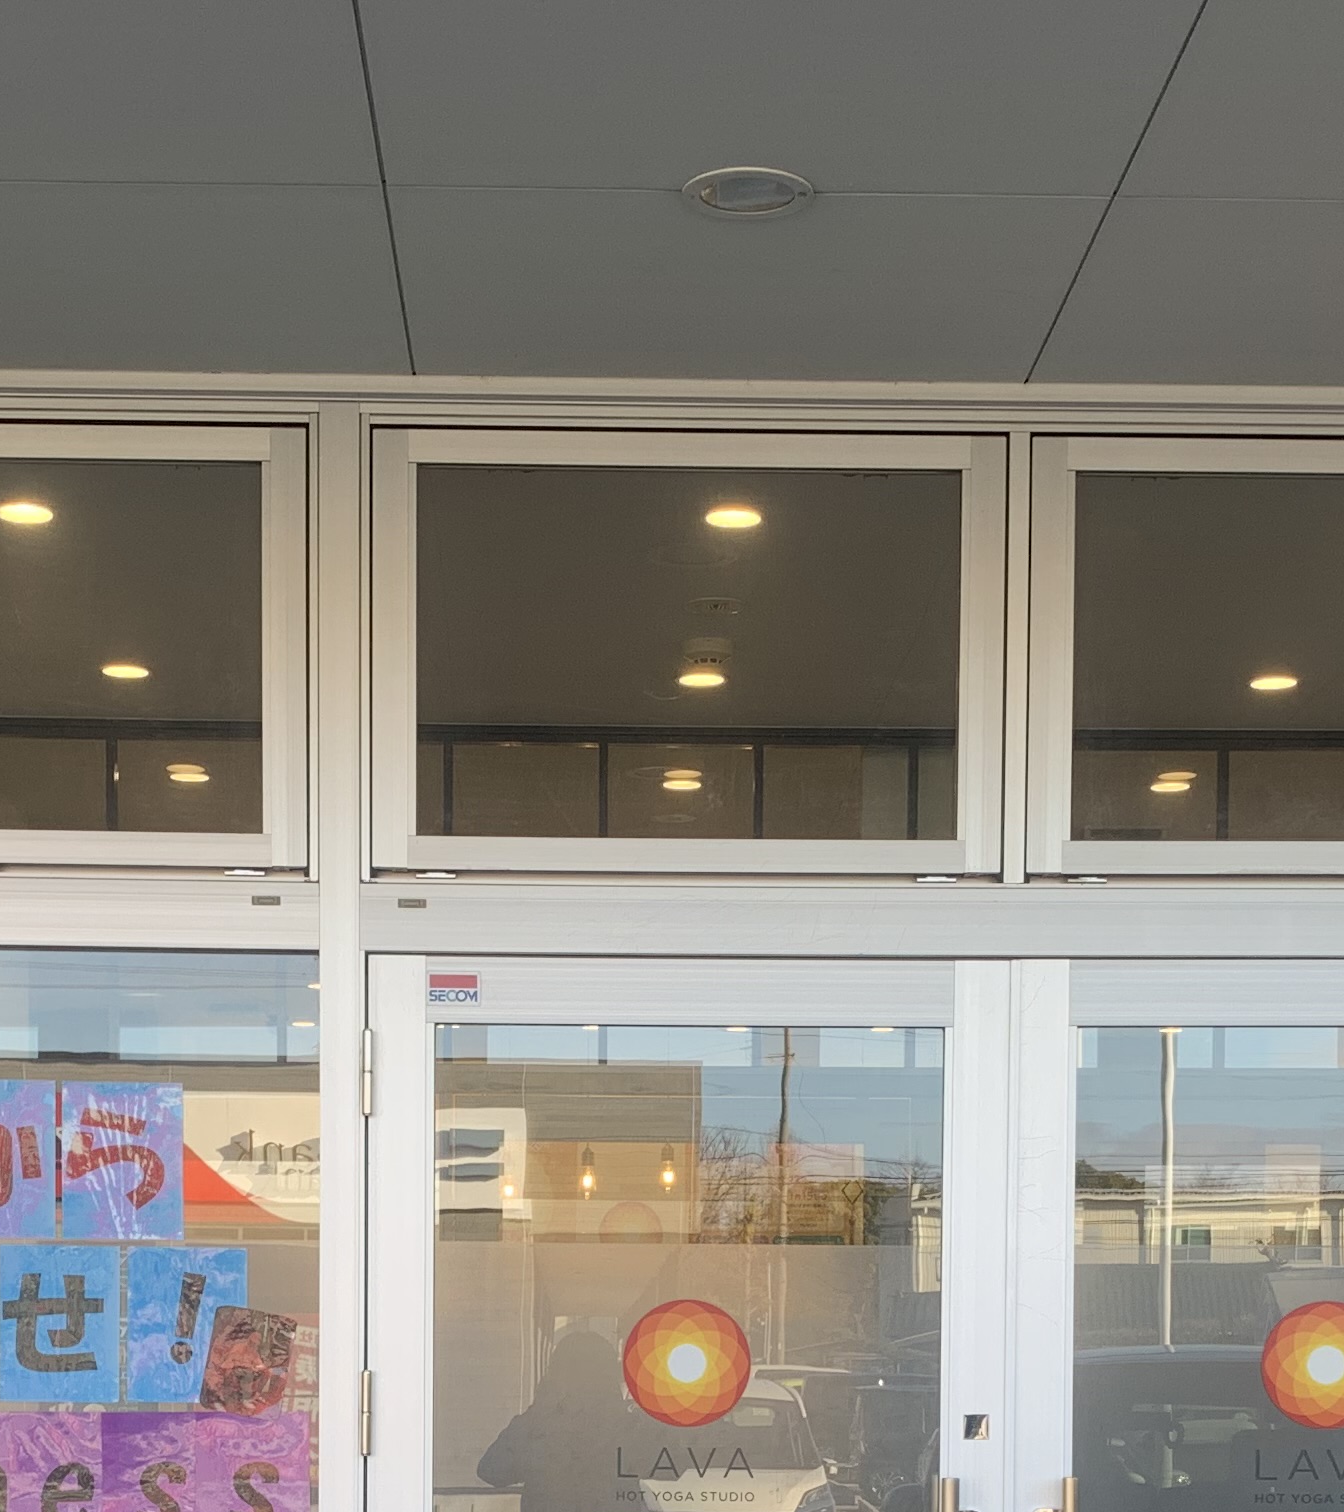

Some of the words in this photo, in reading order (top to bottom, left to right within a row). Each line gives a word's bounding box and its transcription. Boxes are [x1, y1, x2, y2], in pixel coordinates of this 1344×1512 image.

[429, 989, 479, 1003] SECOM
[617, 1446, 754, 1478] LAVA
[616, 1491, 646, 1502] HOT
[652, 1491, 695, 1502] YOGA
[700, 1491, 755, 1502] STUDIO
[1255, 1493, 1285, 1504] HOT
[1291, 1493, 1337, 1504] YOGA
